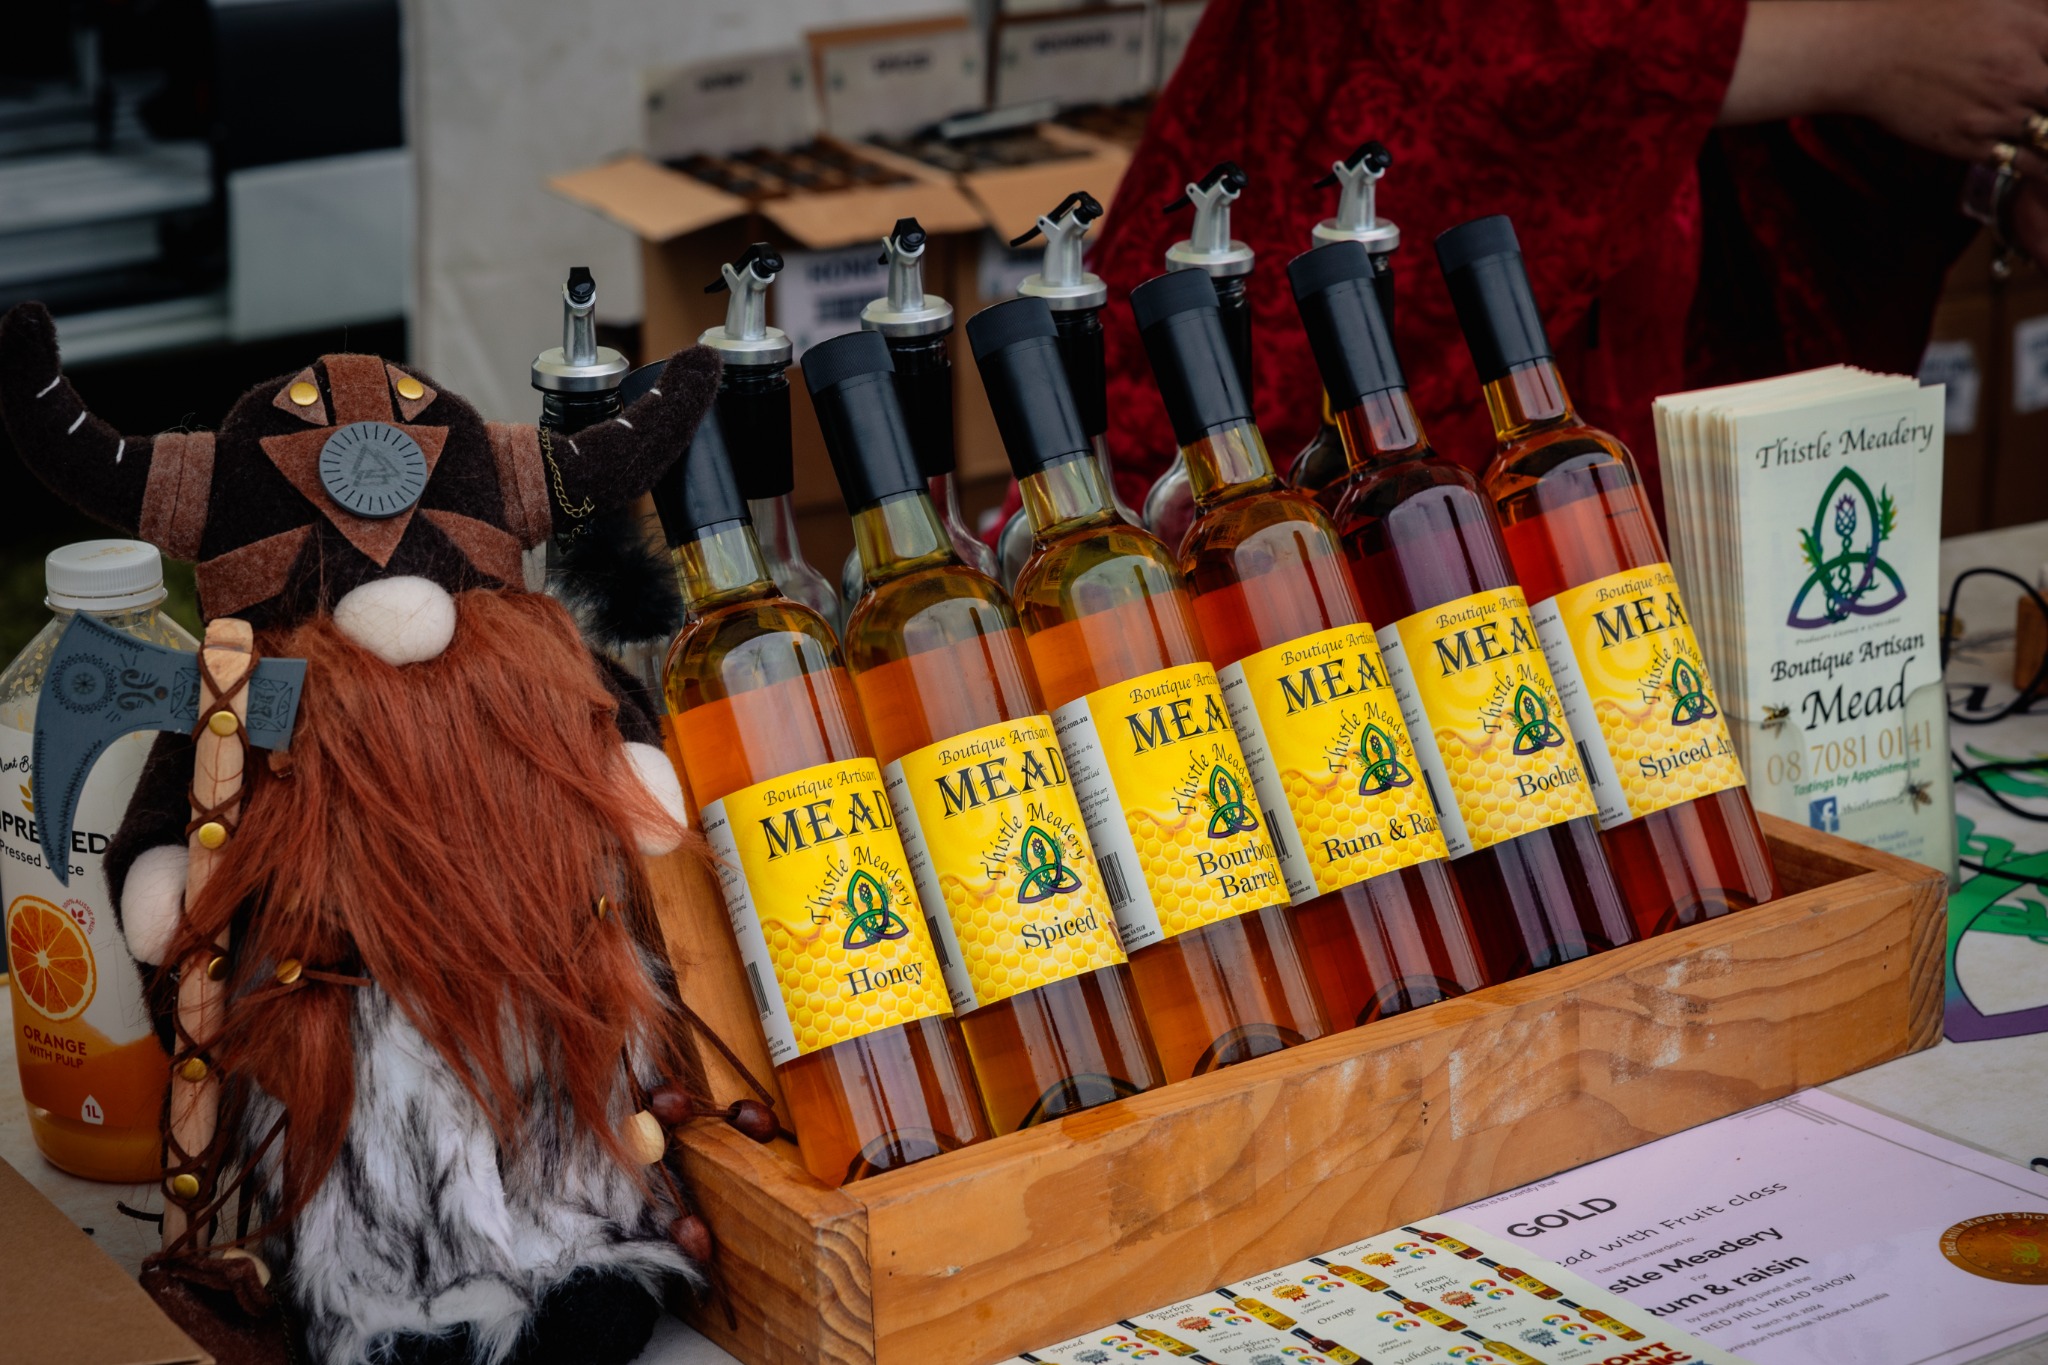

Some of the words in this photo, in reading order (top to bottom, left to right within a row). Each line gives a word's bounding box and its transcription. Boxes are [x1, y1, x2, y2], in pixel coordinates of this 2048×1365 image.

[1756, 430, 1832, 469] Thistle
[1839, 417, 1934, 455] Meadery
[1596, 577, 1653, 603] Boutique
[1436, 601, 1498, 630] Boutique
[1281, 638, 1344, 666] Boutique
[1770, 649, 1854, 682] Boutique
[1859, 633, 1925, 663] Artisan
[1130, 677, 1192, 704] Boutique
[1637, 645, 1672, 706] Thistle
[1802, 655, 1915, 731] Mead
[1477, 671, 1514, 734] Thistle
[1517, 663, 1565, 719] Meadery
[938, 735, 1006, 766] Boutique
[1010, 727, 1050, 746] Artisan
[1322, 709, 1361, 774] Thistle
[1364, 701, 1413, 758] Meadery
[1766, 750, 1801, 786] 08
[1810, 735, 1866, 776] 7081
[1878, 720, 1931, 760] 0141
[1638, 737, 1713, 779] Spiced
[764, 777, 833, 807] Boutique
[837, 768, 876, 787] Artisan
[934, 747, 1068, 820] MEAD
[1171, 750, 1209, 816] Thistle
[1513, 763, 1582, 798] Bochet
[1793, 778, 1834, 797] Tastings
[1836, 772, 1849, 788] by
[1851, 757, 1920, 782] Appointment
[759, 790, 893, 862] MEAD
[982, 812, 1023, 881] Thistle
[1027, 802, 1086, 861] Meadery
[1320, 828, 1384, 864] Rum
[1389, 817, 1407, 841] &
[1193, 839, 1274, 878] Bourbon
[805, 855, 848, 925] Thistle
[854, 846, 912, 905] Meadery
[1216, 864, 1280, 900] Barrel
[1021, 908, 1099, 949] Spiced
[845, 961, 922, 996] Honey
[24, 1025, 87, 1056] ORANGE
[28, 1043, 52, 1061] WITH
[55, 1052, 83, 1069] PULP
[85, 1104, 100, 1119] 1L
[1467, 1203, 1488, 1211] This
[1510, 1186, 1539, 1199] certify
[2011, 1212, 2048, 1220] Sho
[1507, 1198, 1617, 1238] GOLD
[1599, 1228, 1660, 1252] with
[1659, 1205, 1725, 1230] Fruit
[1729, 1182, 1788, 1207] class
[1944, 1226, 1965, 1241] Hill
[1960, 1213, 2006, 1228] Mead
[1595, 1265, 1614, 1274] has
[1615, 1255, 1642, 1267] been
[1642, 1242, 1683, 1258] awarded
[1609, 1271, 1663, 1295] stle
[1659, 1226, 1784, 1273] Meadery
[1942, 1241, 1959, 1256] Red
[1253, 1278, 1291, 1292] Raisin
[1414, 1273, 1449, 1290] Lemon
[1422, 1278, 1461, 1294] Myrtle
[1690, 1273, 1709, 1282] For
[1704, 1284, 1735, 1295] &
[1732, 1256, 1810, 1287] raisin
[1700, 1320, 1733, 1333] RED
[1733, 1307, 1769, 1321] HILL
[1768, 1290, 1811, 1309] MEAD
[1811, 1273, 1857, 1293] SHOW
[1702, 1308, 1719, 1318] the
[1718, 1296, 1755, 1315] judging
[1755, 1286, 1782, 1301] panel
[1782, 1281, 1793, 1290] at
[1794, 1275, 1812, 1285] the
[1851, 1291, 1890, 1309] Australia
[1317, 1307, 1357, 1326] Orange
[1493, 1316, 1528, 1331] Freya
[1752, 1317, 1783, 1331] March
[1802, 1303, 1825, 1315] 2024
[1050, 1338, 1085, 1354] Spiced
[1220, 1336, 1281, 1355] Blackberry
[1394, 1344, 1441, 1365] Valhalla
[1602, 1341, 1672, 1365] ON'T
